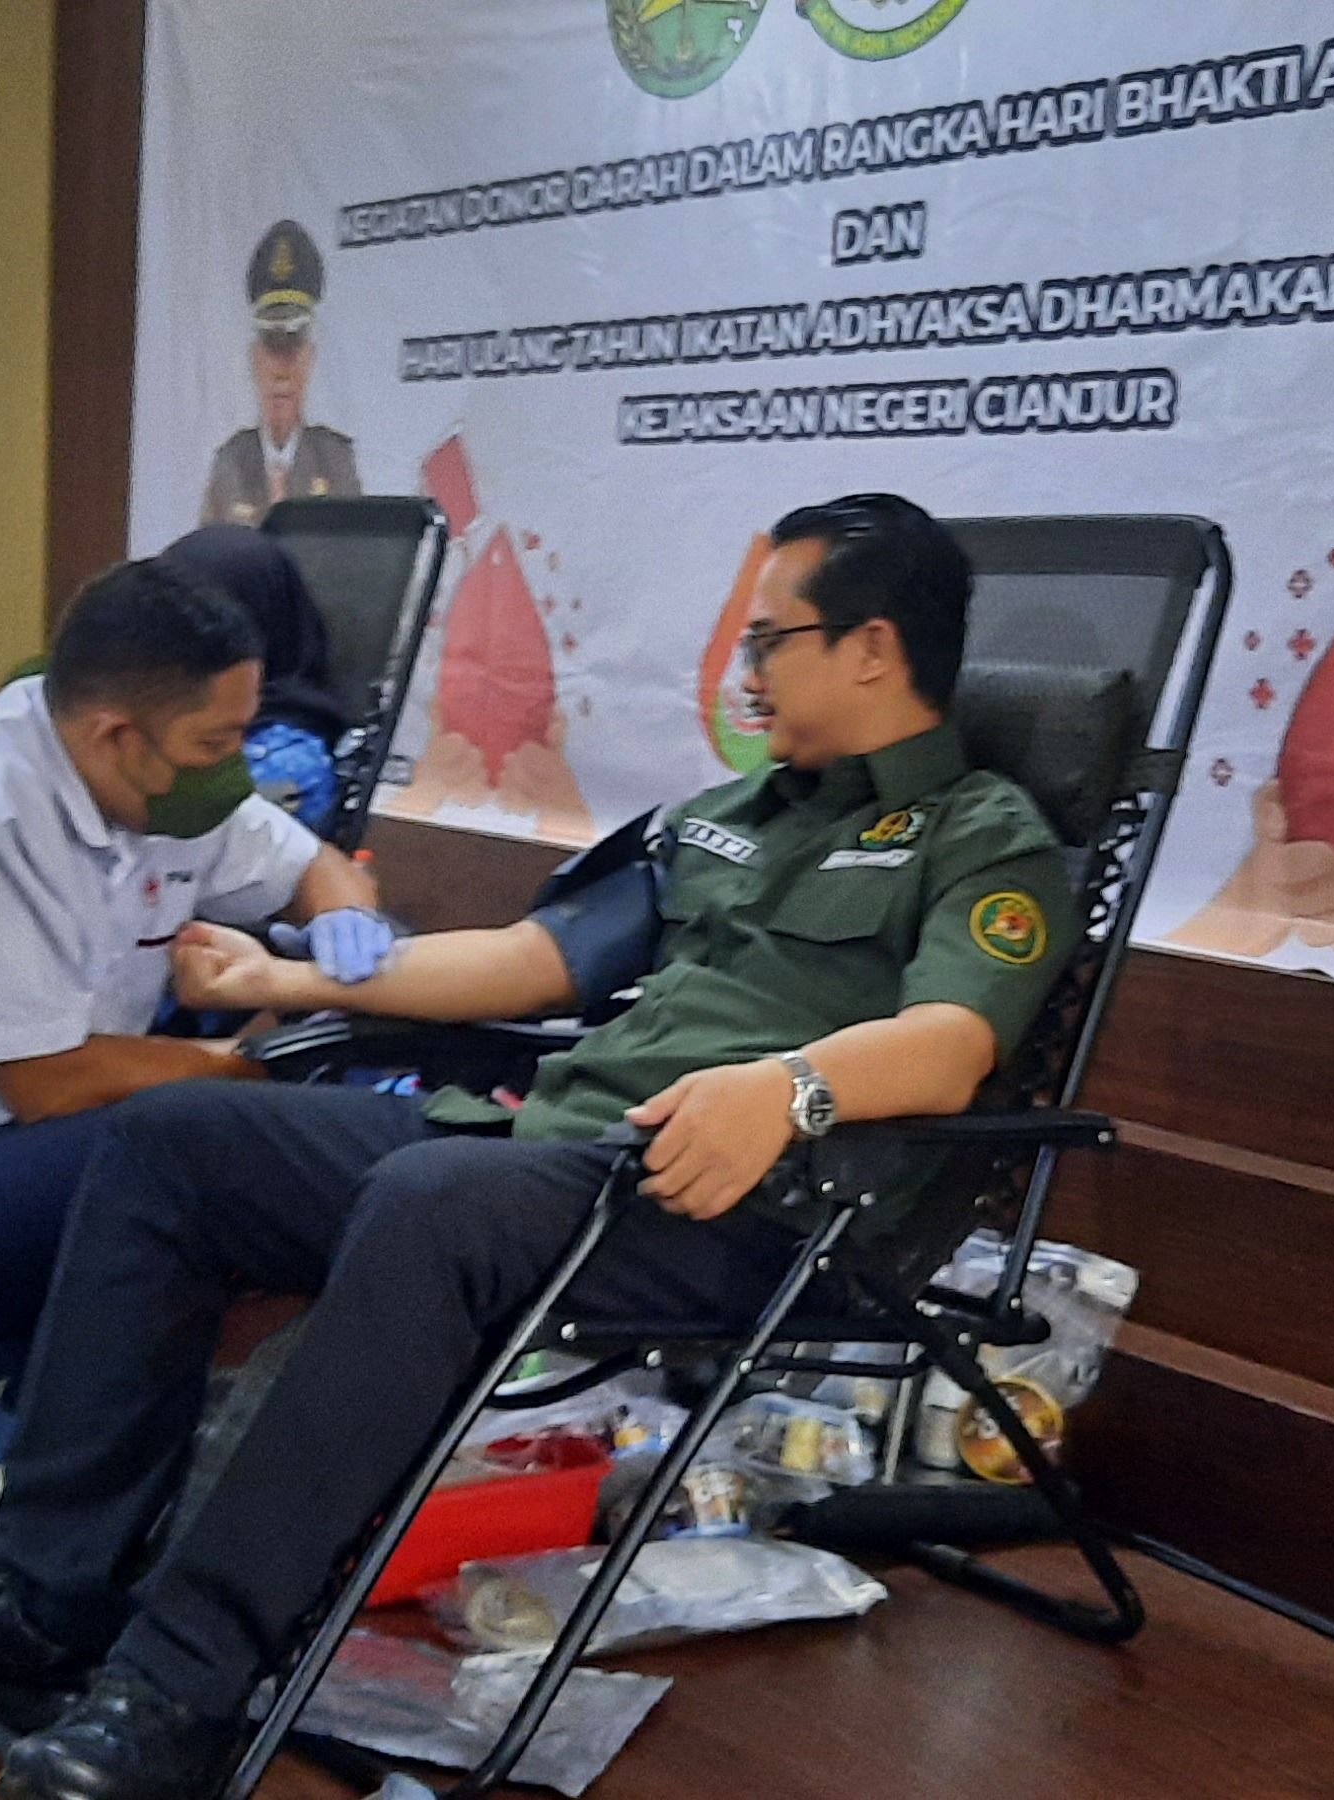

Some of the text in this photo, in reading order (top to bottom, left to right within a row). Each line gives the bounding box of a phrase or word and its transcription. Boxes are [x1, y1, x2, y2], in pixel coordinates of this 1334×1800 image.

[464, 174, 567, 228] DONOR
[571, 154, 686, 211] DARAH
[689, 131, 816, 193] DALAM
[821, 106, 989, 174] RANGKA
[996, 86, 1108, 147] HARI
[1114, 54, 1304, 128] BHAKTI
[835, 206, 926, 260] DAN
[569, 321, 679, 369] TAHUN
[680, 307, 808, 358] IKATAN
[812, 290, 1033, 348] ADHYAKSA
[619, 376, 1175, 440] KEJAKSAAN NEGERI CIANJUR
